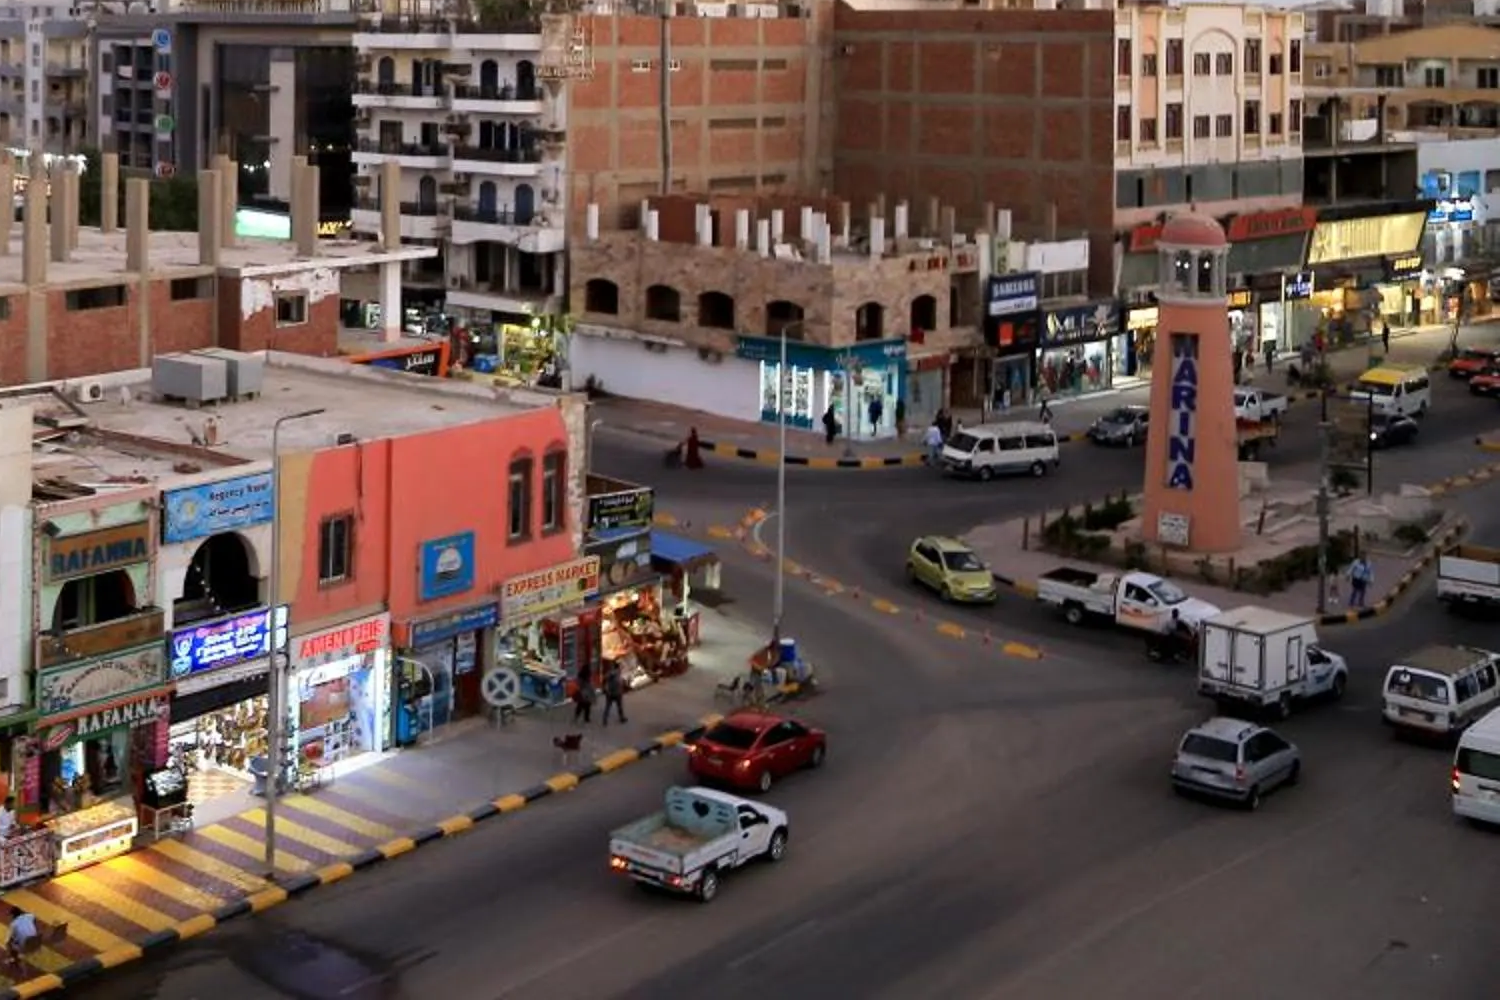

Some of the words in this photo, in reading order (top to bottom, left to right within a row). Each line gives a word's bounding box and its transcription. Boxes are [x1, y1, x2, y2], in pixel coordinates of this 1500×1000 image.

[1169, 335, 1198, 490] MARINA
[507, 571, 554, 598] EXPRESS
[555, 560, 598, 583] MARKET
